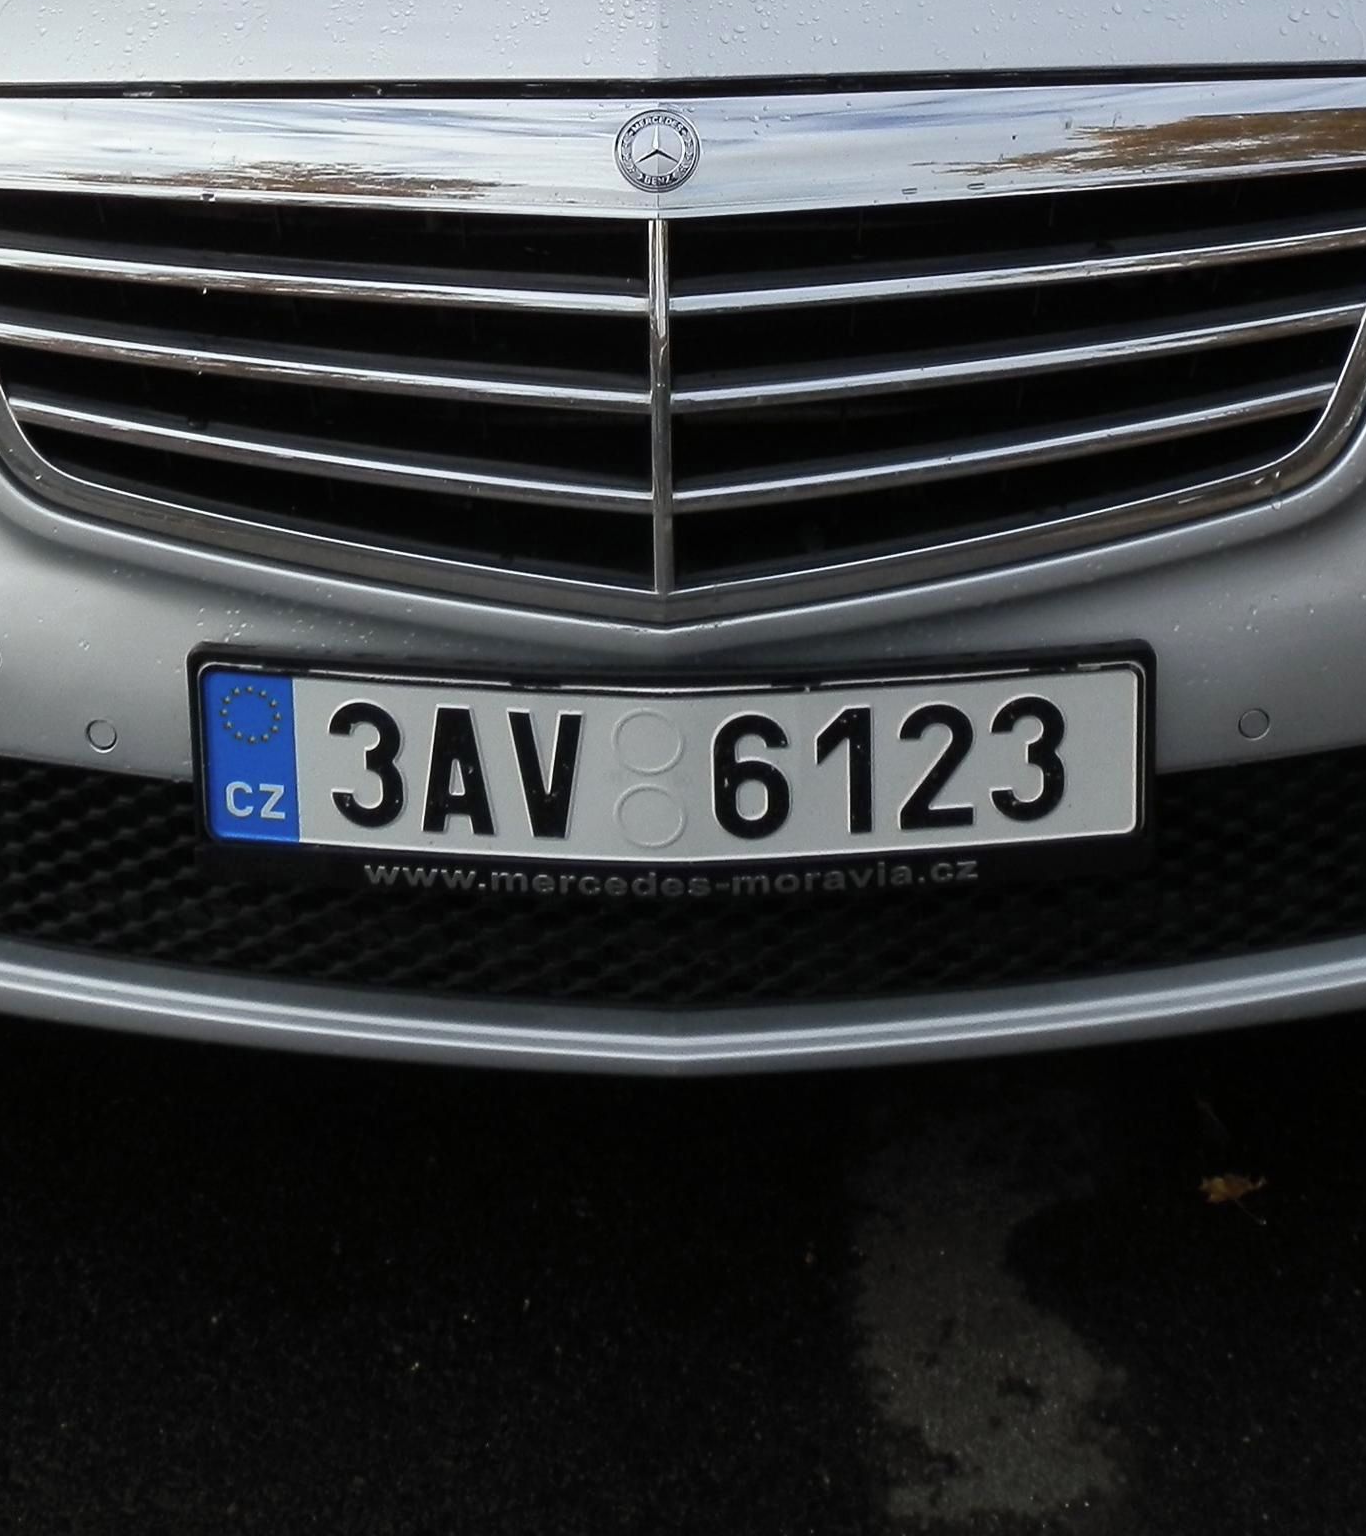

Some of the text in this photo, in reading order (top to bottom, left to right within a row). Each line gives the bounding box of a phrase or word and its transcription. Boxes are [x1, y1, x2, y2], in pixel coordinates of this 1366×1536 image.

[631, 116, 684, 131] MERCEDES
[644, 175, 671, 185] BENZ
[328, 695, 1066, 840] 3AV 6123
[225, 781, 286, 820] CZ
[364, 860, 979, 897] www.mercedes-moravia.cz
